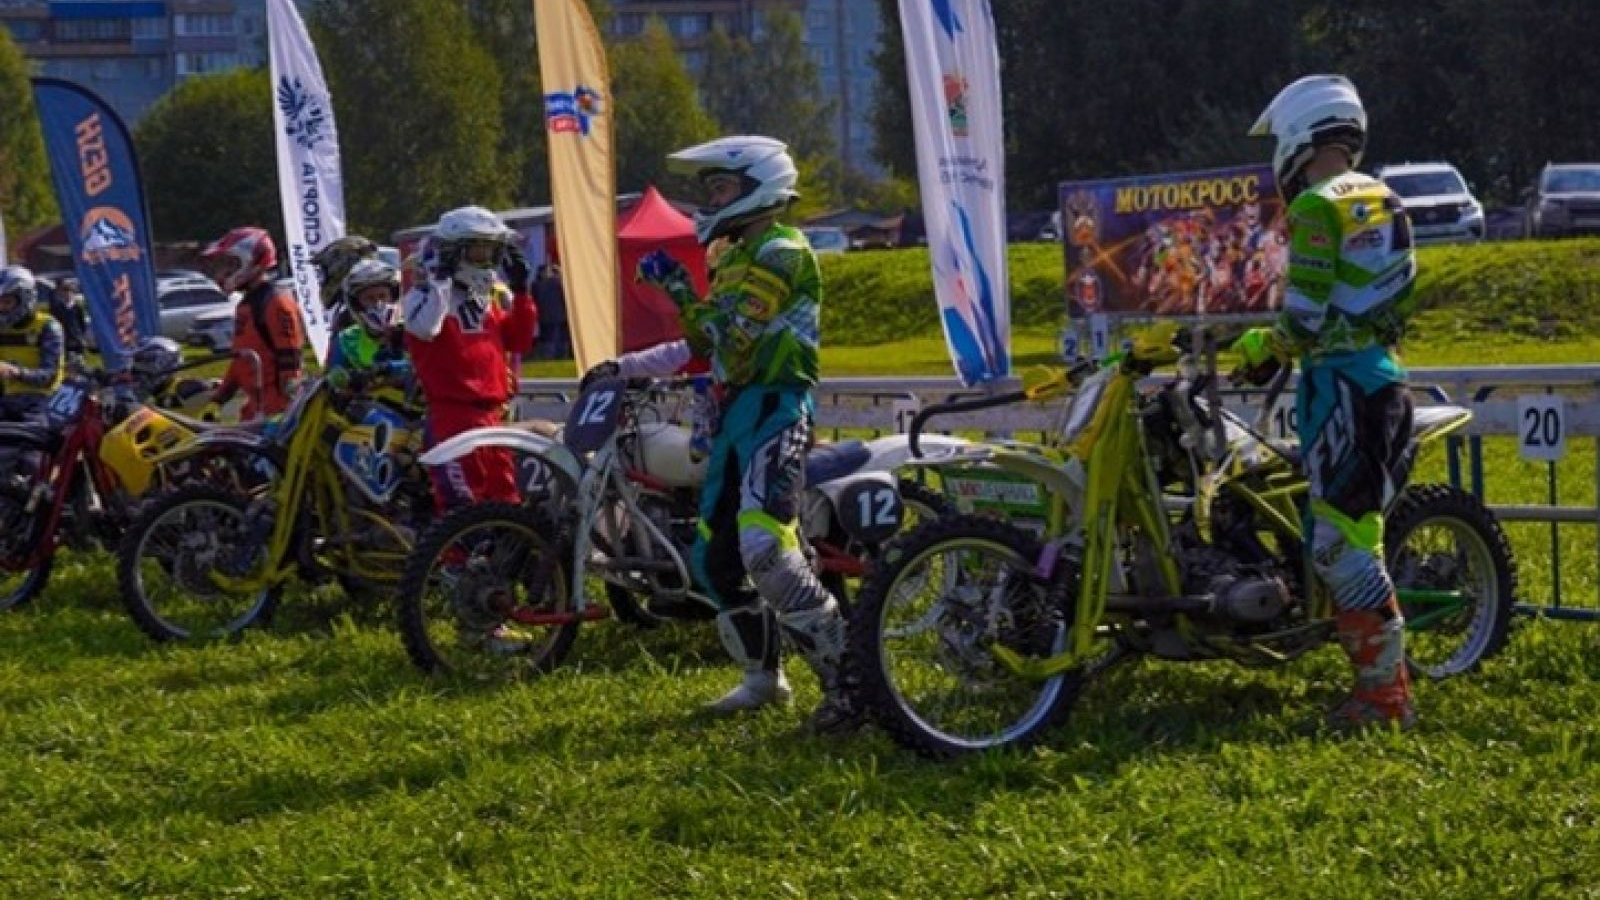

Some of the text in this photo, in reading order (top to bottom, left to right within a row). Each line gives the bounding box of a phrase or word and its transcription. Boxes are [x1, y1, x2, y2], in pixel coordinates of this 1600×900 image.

[1115, 174, 1260, 214] МОТОКРОСС
[577, 390, 617, 426] 12
[1524, 407, 1560, 446] 20
[857, 488, 897, 528] 12
